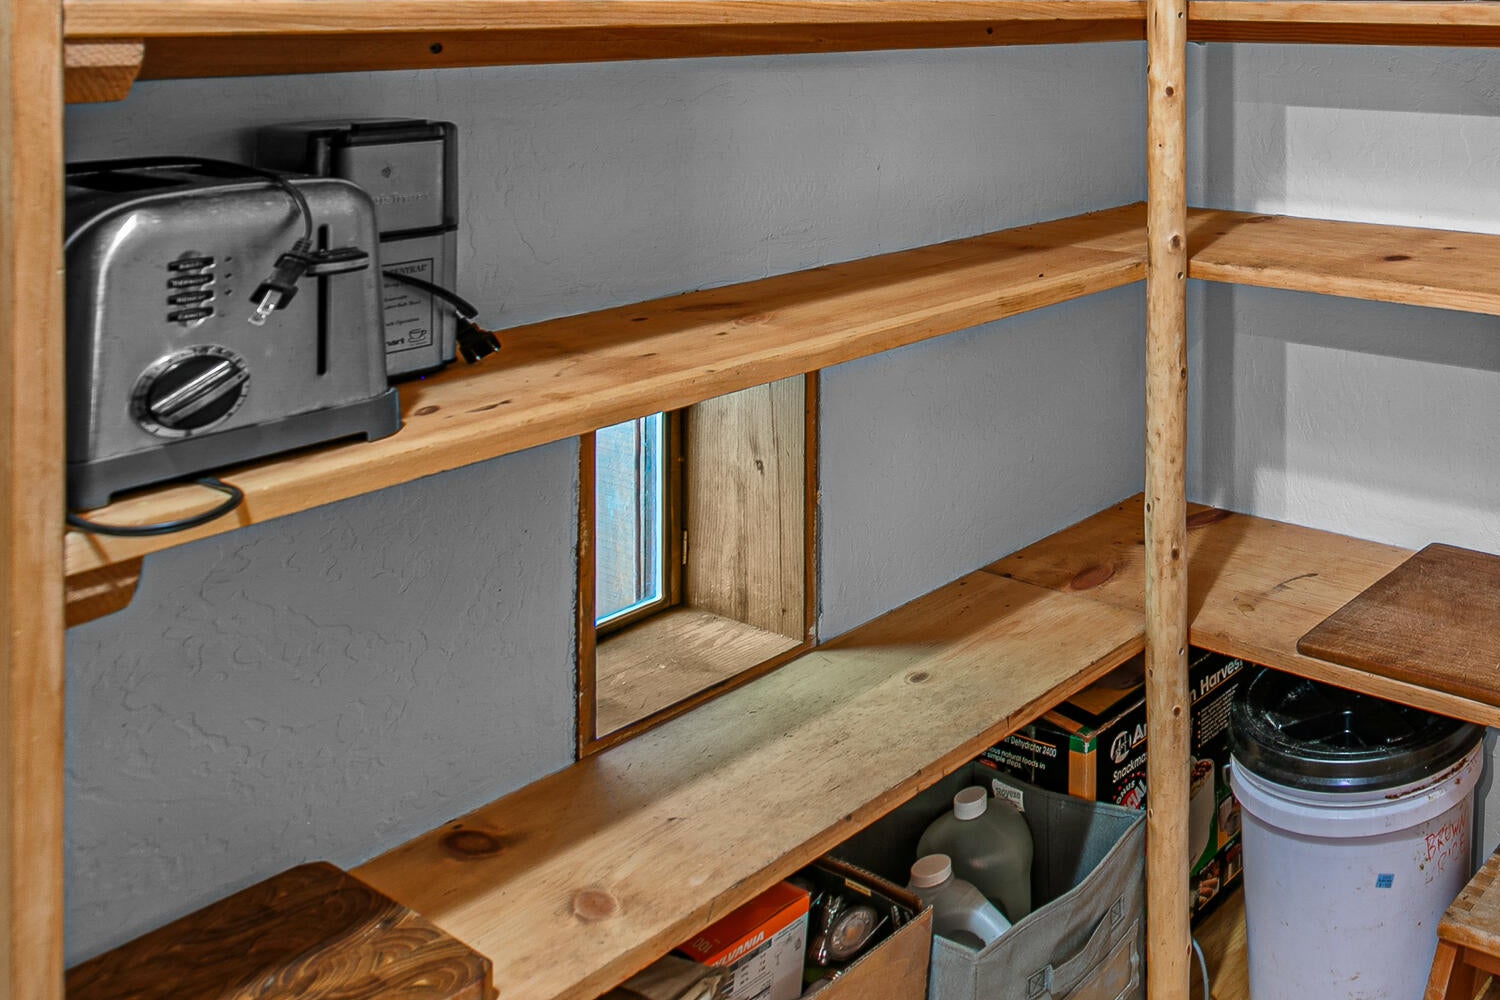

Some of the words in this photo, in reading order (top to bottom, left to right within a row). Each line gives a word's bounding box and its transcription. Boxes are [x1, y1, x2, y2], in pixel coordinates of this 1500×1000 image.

[1011, 736, 1042, 753] Dehydrator
[1042, 745, 1057, 758] 2400
[986, 752, 1006, 764] simple
[1006, 758, 1022, 769] steps.
[1001, 748, 1021, 762] natural
[1022, 756, 1039, 769] foods
